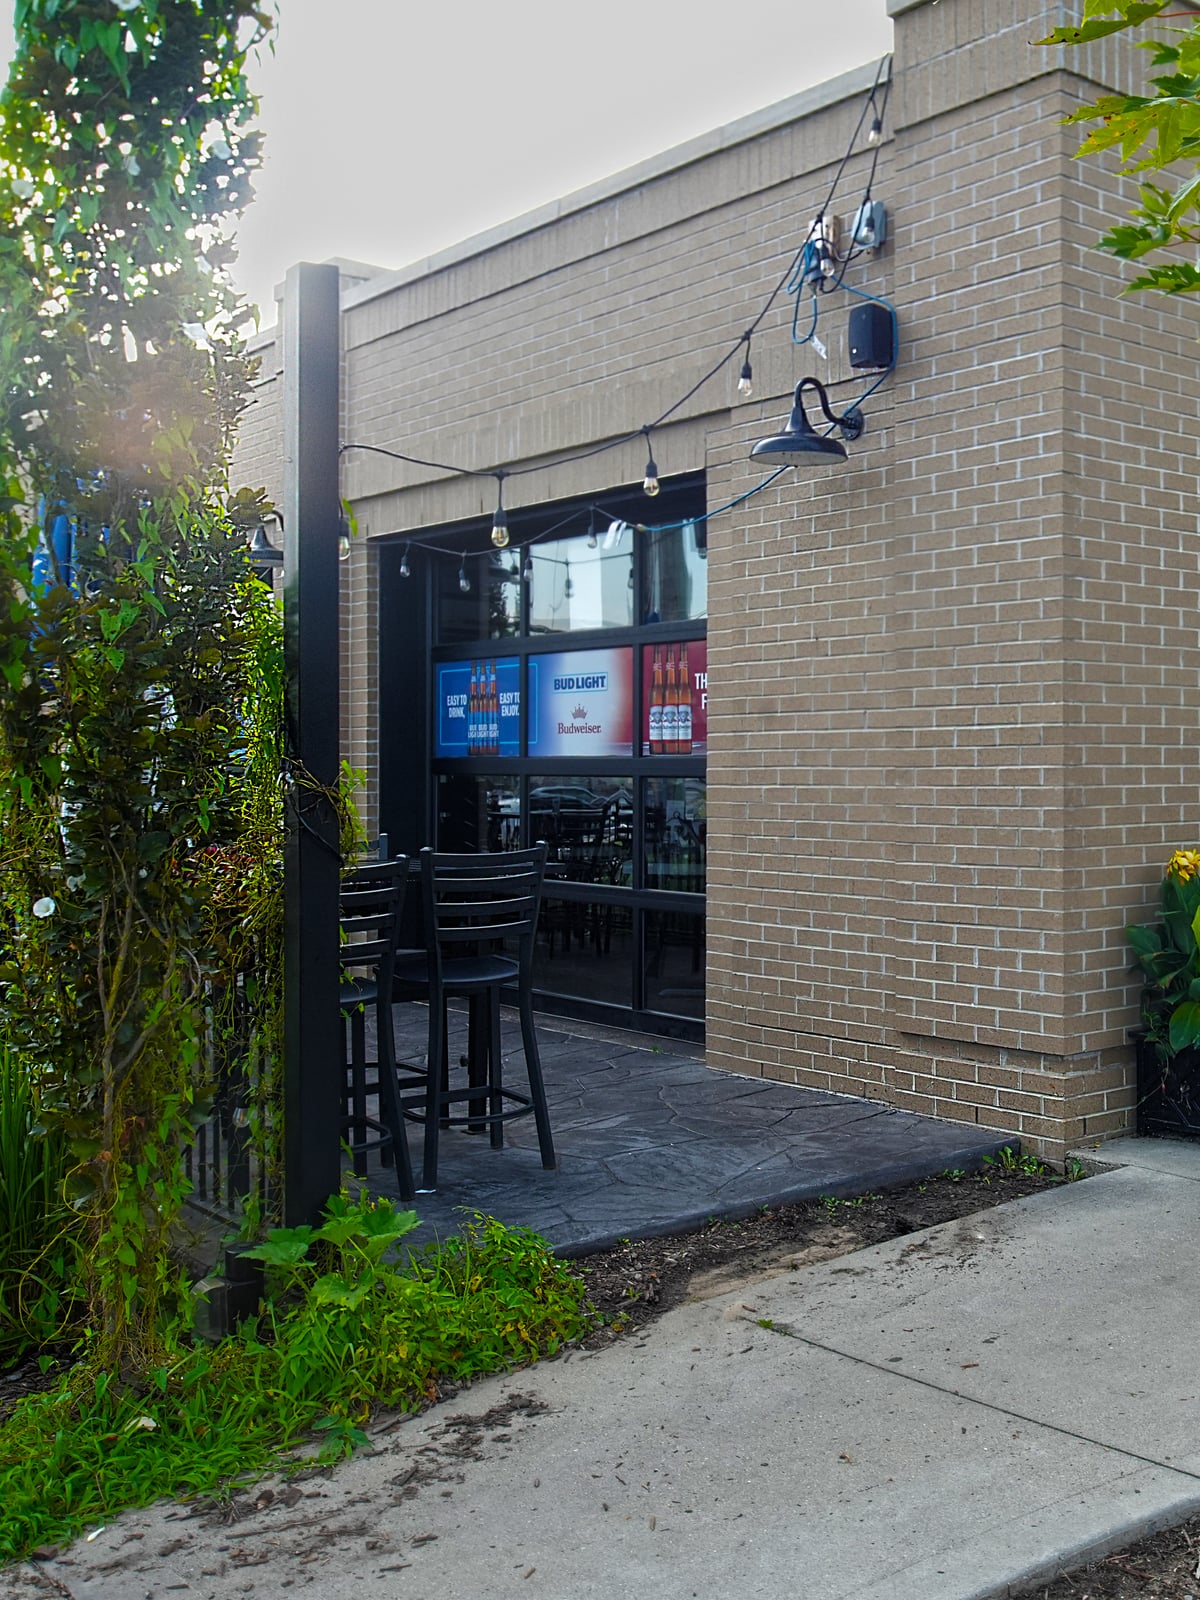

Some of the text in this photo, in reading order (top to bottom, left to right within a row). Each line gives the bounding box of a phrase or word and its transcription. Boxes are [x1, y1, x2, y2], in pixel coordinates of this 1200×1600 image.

[553, 675, 606, 690] BUD LIGHT
[447, 694, 468, 706] EASY TO
[499, 692, 514, 704] EASY
